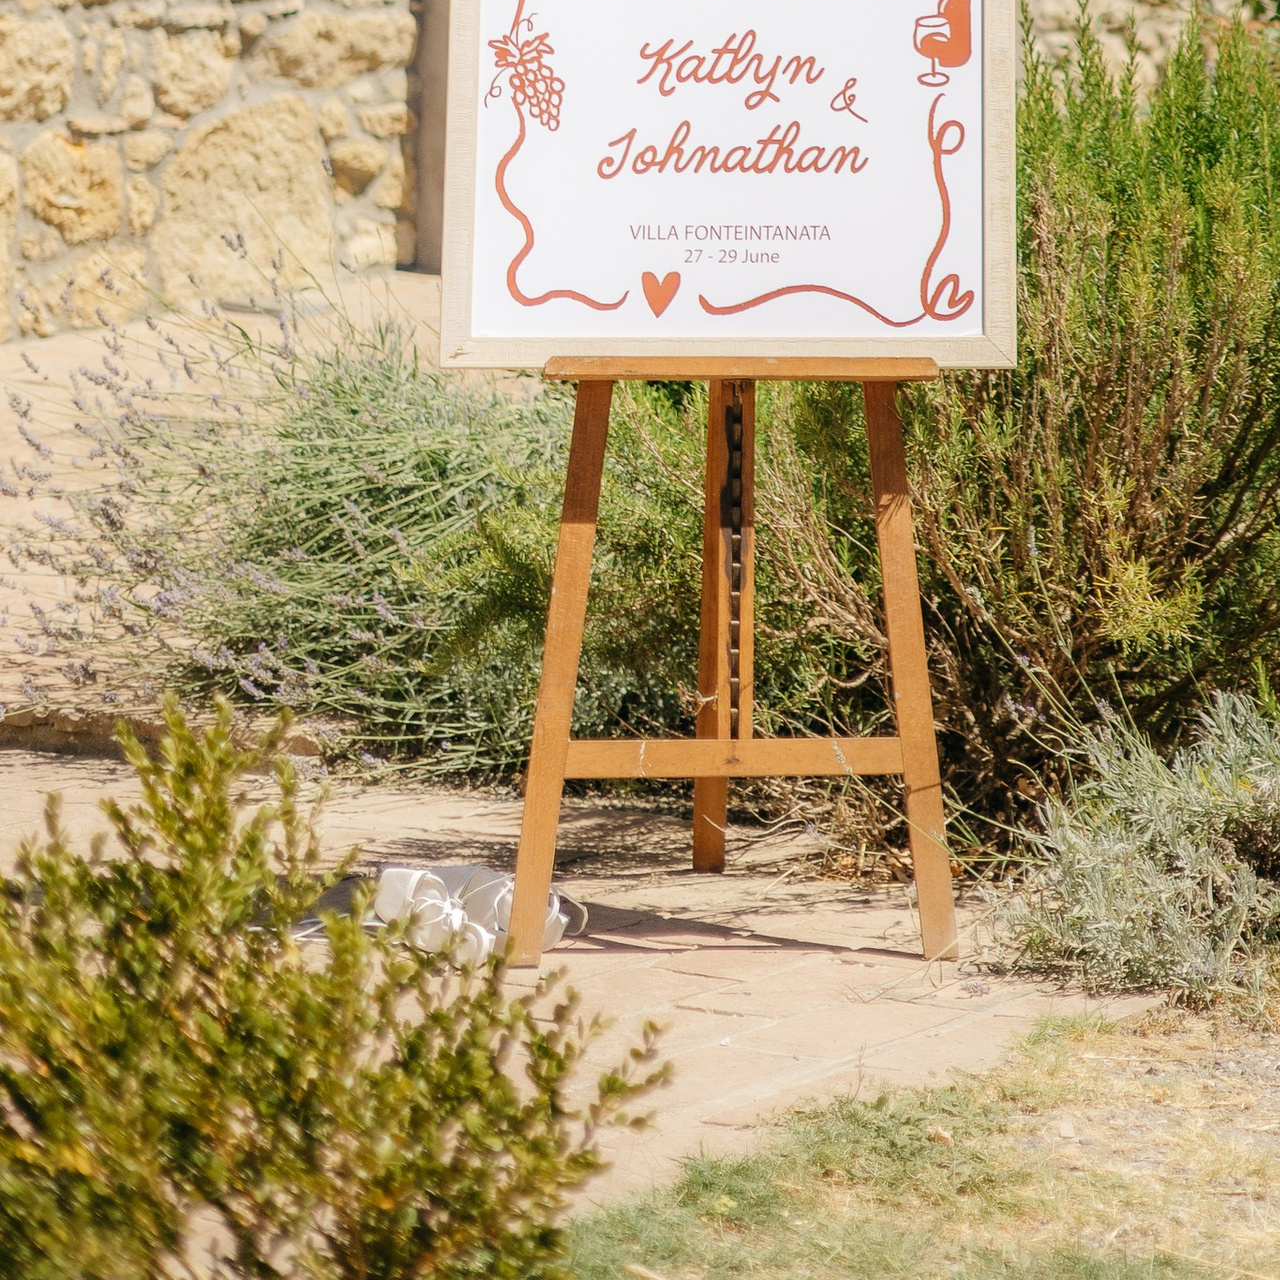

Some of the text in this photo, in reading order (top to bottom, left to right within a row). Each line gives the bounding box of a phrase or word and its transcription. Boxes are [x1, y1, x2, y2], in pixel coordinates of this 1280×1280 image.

[637, 29, 868, 123] Katlyn &
[597, 120, 869, 180] Johnathan
[629, 224, 832, 241] VILLA FONTEINTANATA
[683, 248, 704, 264] 27
[718, 248, 738, 264] 29
[741, 248, 781, 264] June
